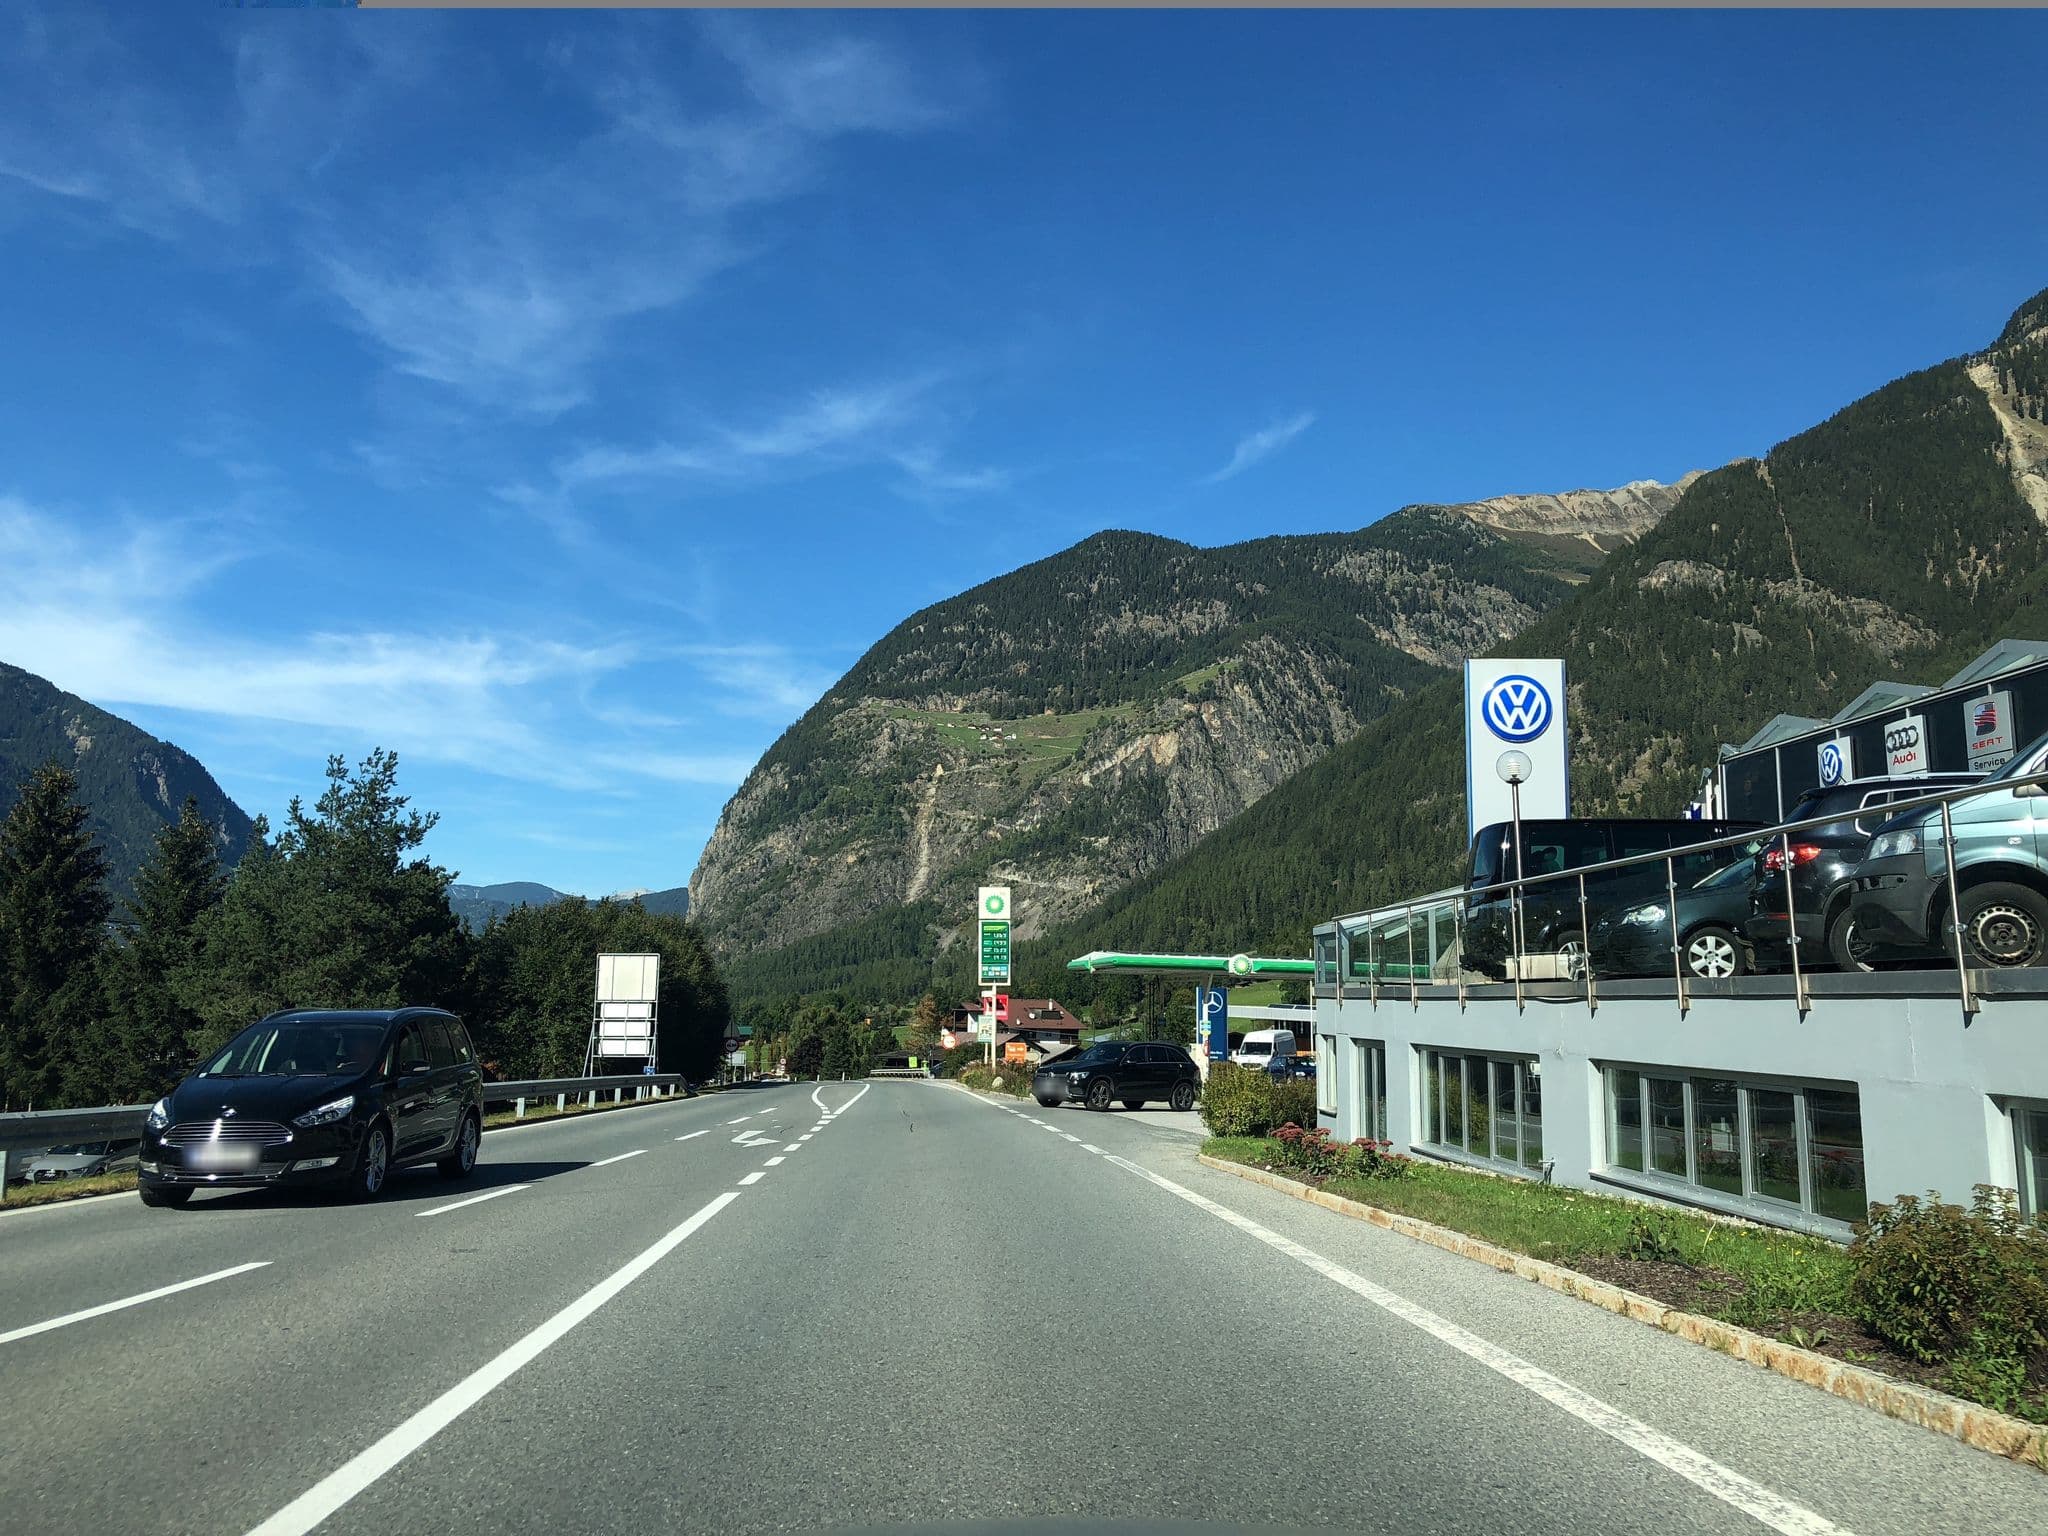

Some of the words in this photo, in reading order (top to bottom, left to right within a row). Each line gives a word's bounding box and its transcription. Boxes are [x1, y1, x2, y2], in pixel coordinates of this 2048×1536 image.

[1972, 736, 2003, 750] SEAT
[1892, 752, 1917, 766] Audi
[1974, 757, 2006, 770] Service
